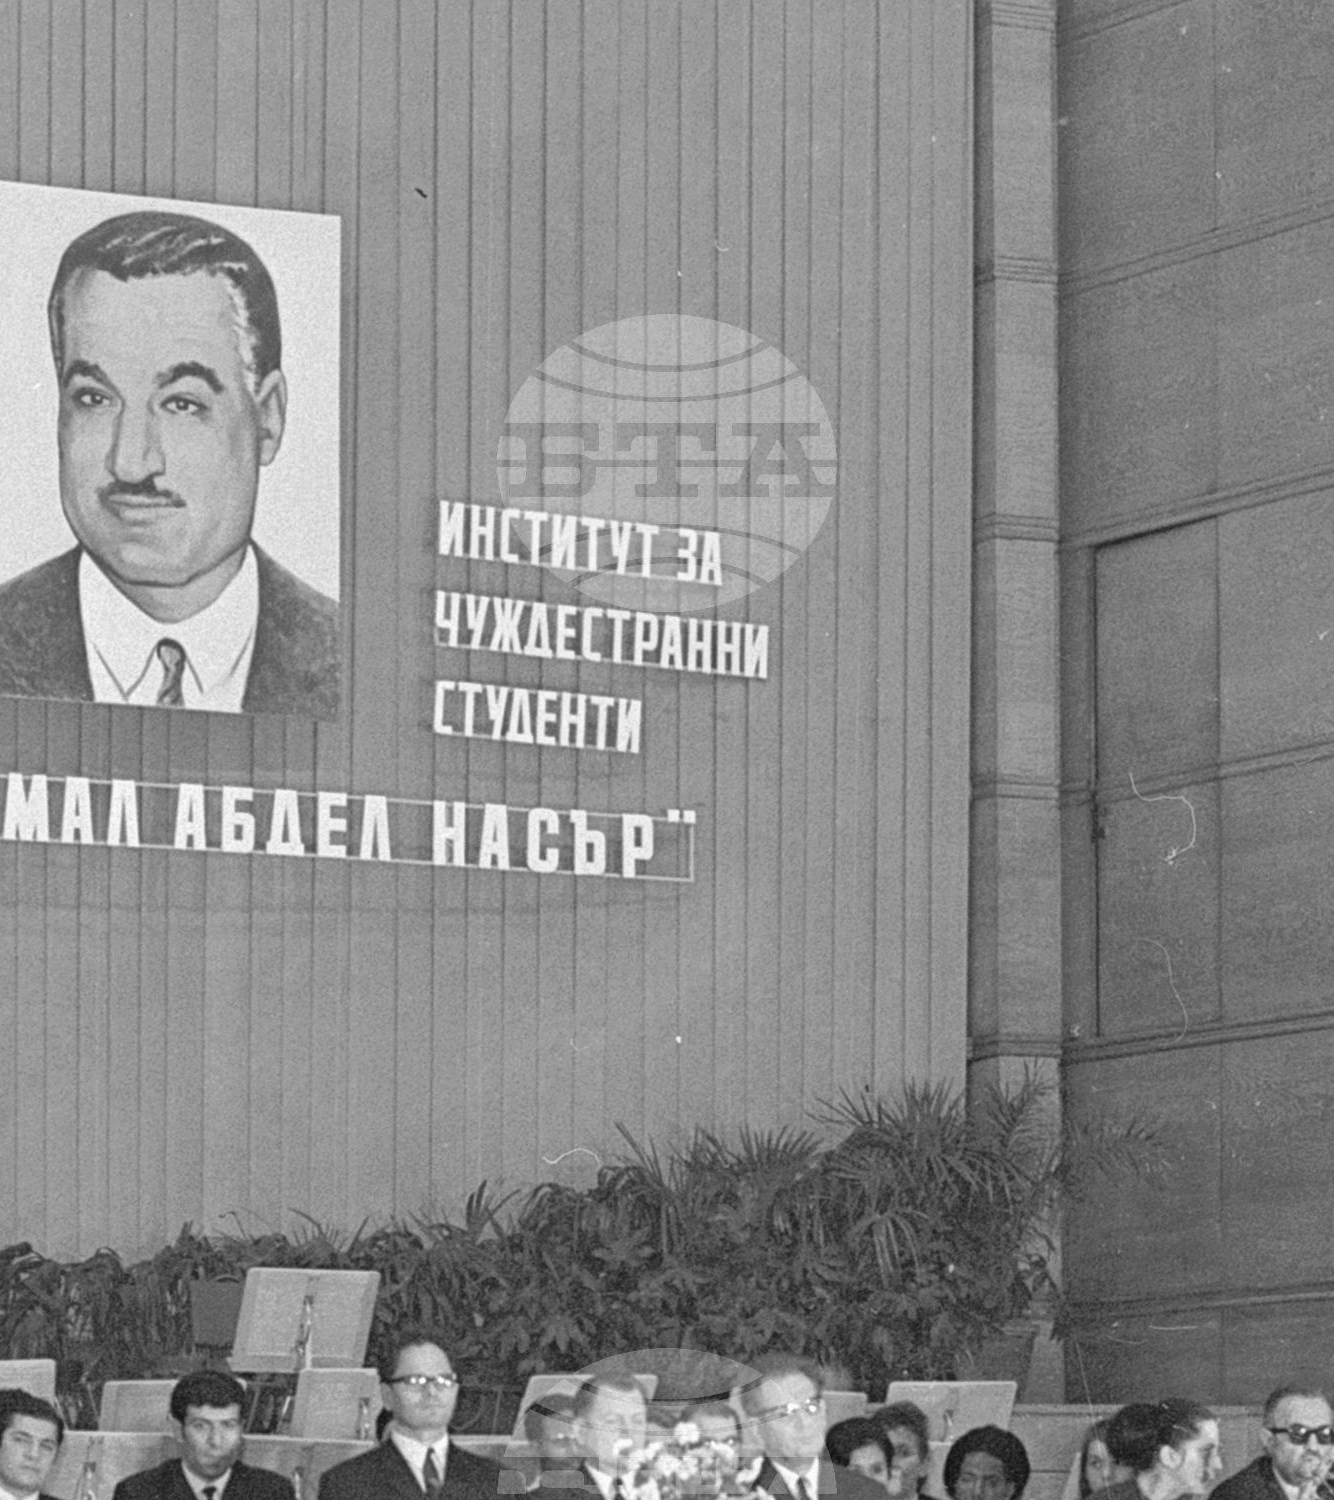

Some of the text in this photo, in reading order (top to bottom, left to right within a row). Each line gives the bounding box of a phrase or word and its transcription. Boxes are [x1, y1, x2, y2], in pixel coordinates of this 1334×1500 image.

[439, 499, 723, 586] ИНСТИТУТ ЗА
[434, 589, 770, 680] ЧУЖДЕСТРАННИ
[433, 679, 643, 755] СТУДЕНТИ
[173, 782, 392, 862] АБДЕЛ
